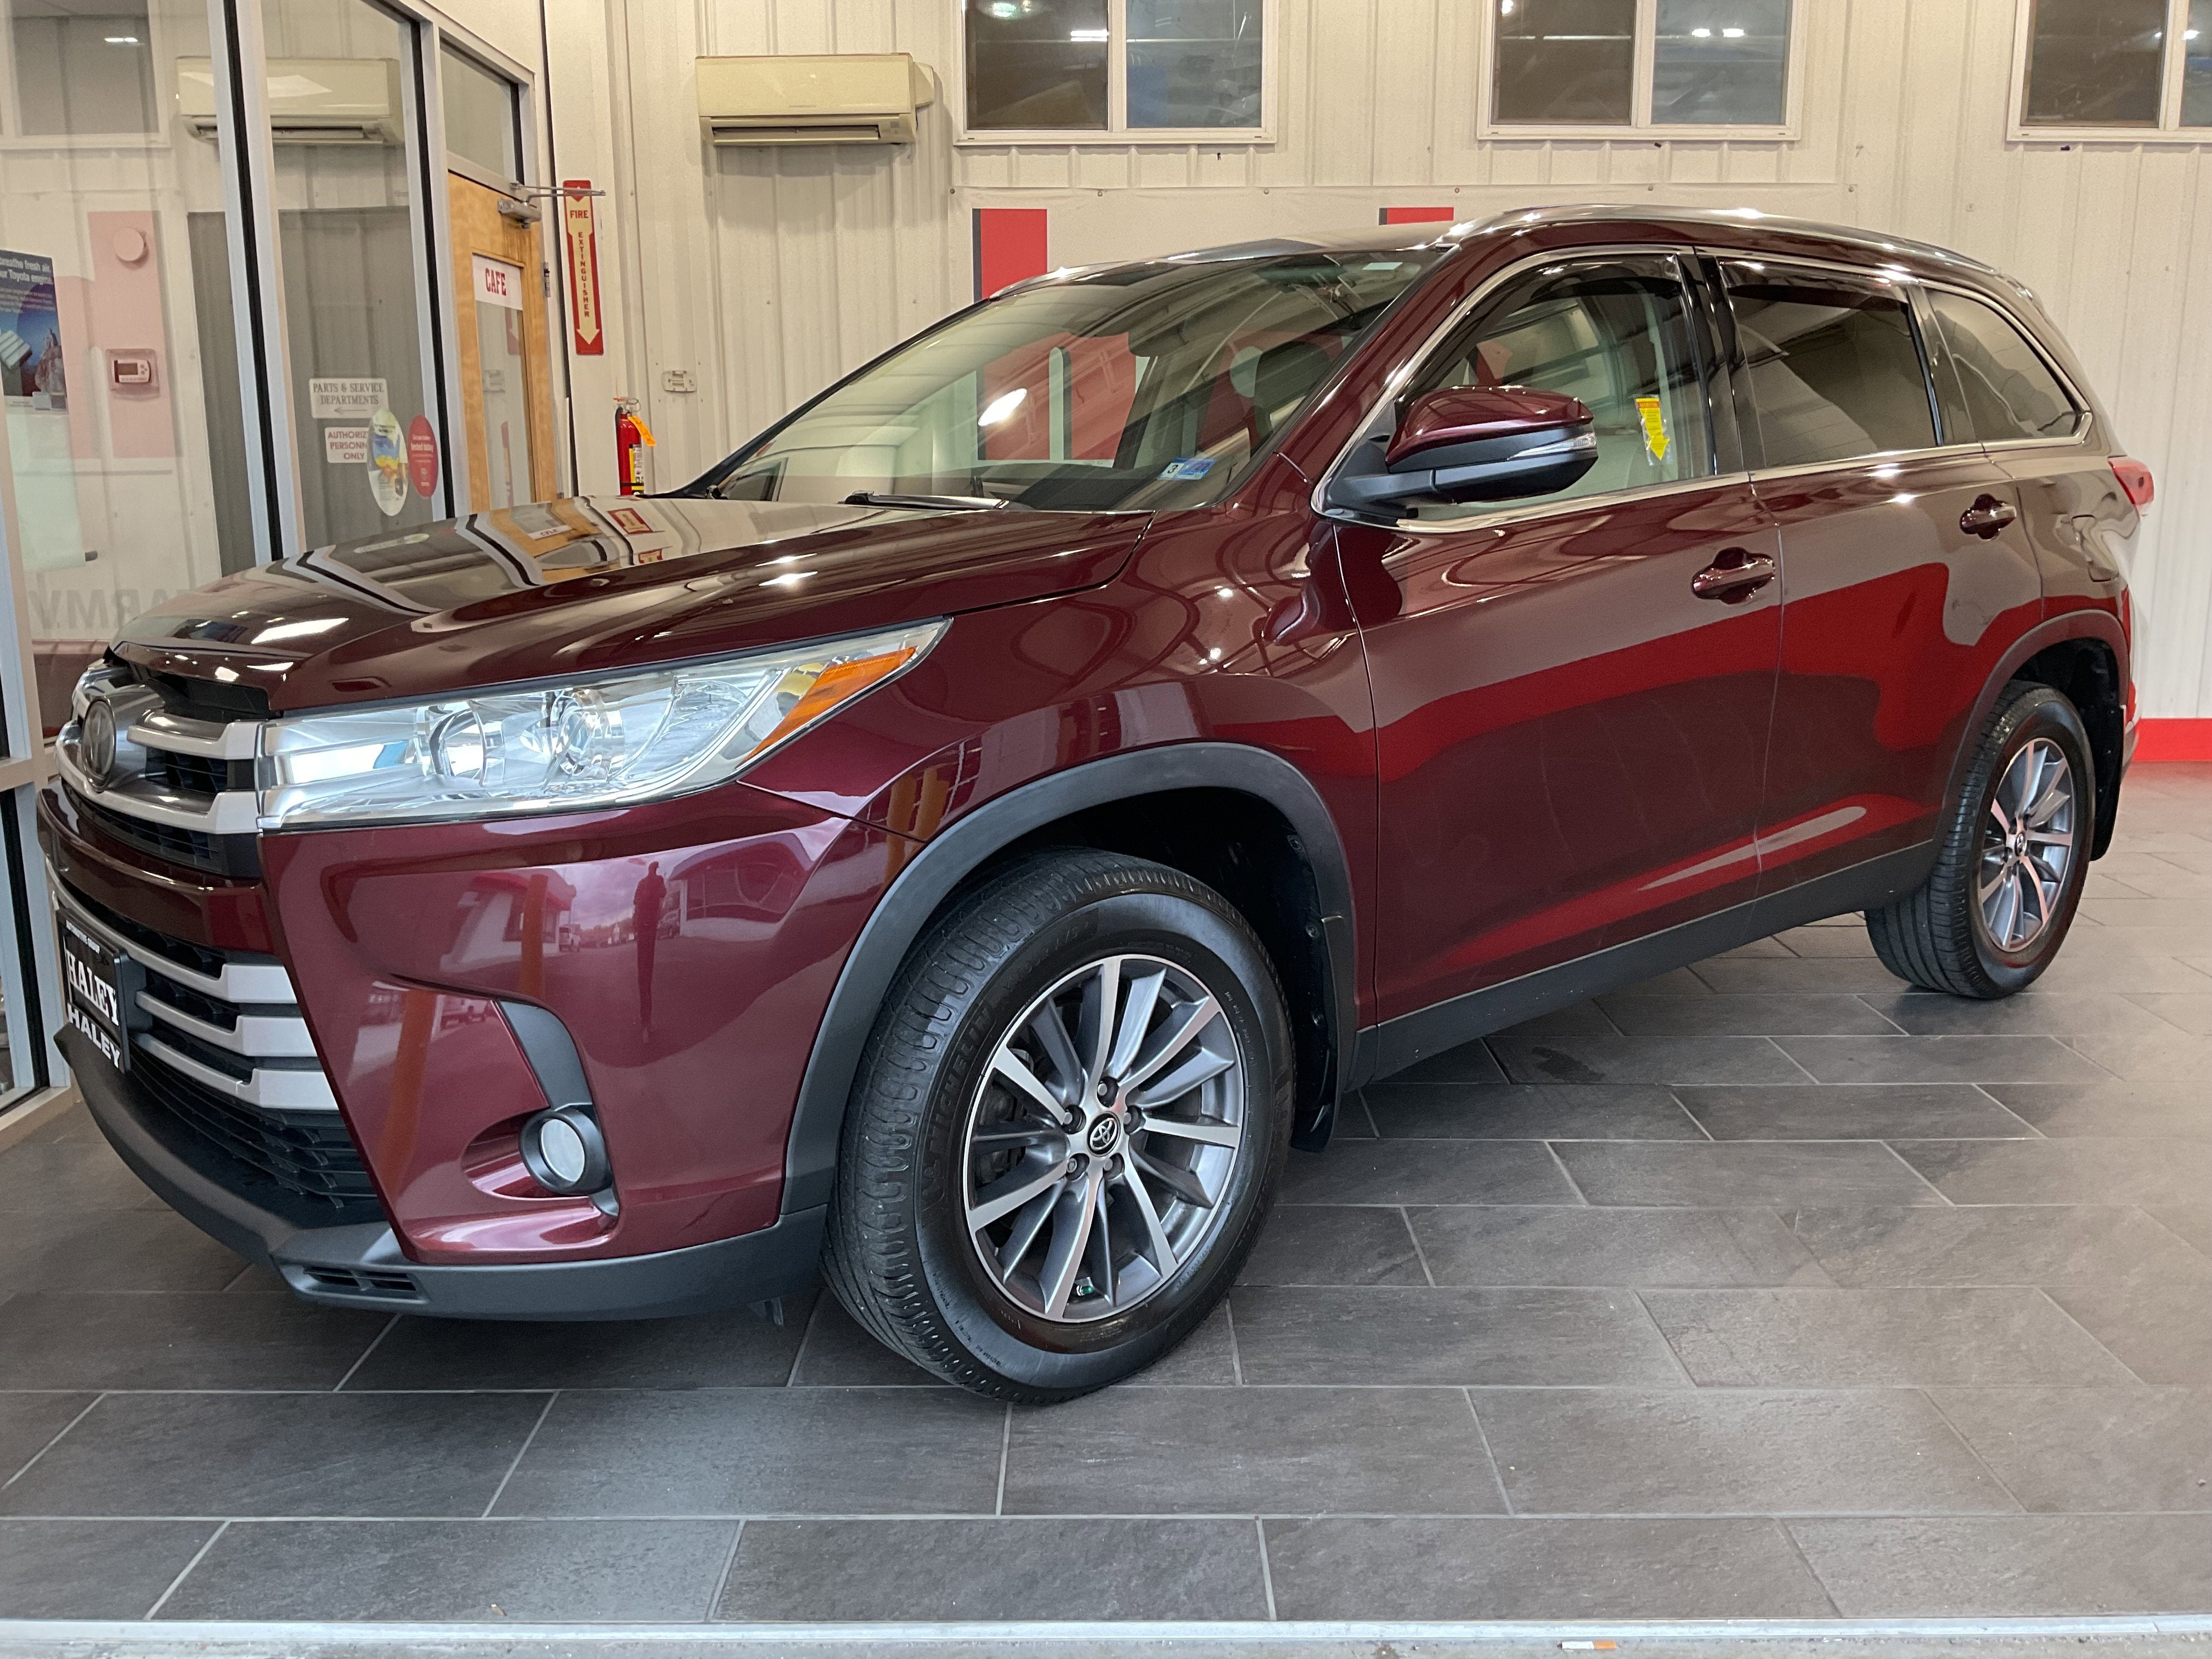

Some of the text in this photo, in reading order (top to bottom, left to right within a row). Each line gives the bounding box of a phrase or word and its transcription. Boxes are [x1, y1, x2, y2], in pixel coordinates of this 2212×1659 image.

[569, 210, 589, 219] FIRE
[8, 269, 30, 283] Toyota
[485, 267, 507, 296] CAFE
[578, 232, 590, 317] EXTINGUISHER
[313, 383, 385, 393] PARTS & SERVICE
[320, 395, 379, 405] DEPARTMENTS
[65, 949, 119, 1026] HALEY
[67, 1002, 120, 1069] HALEY
